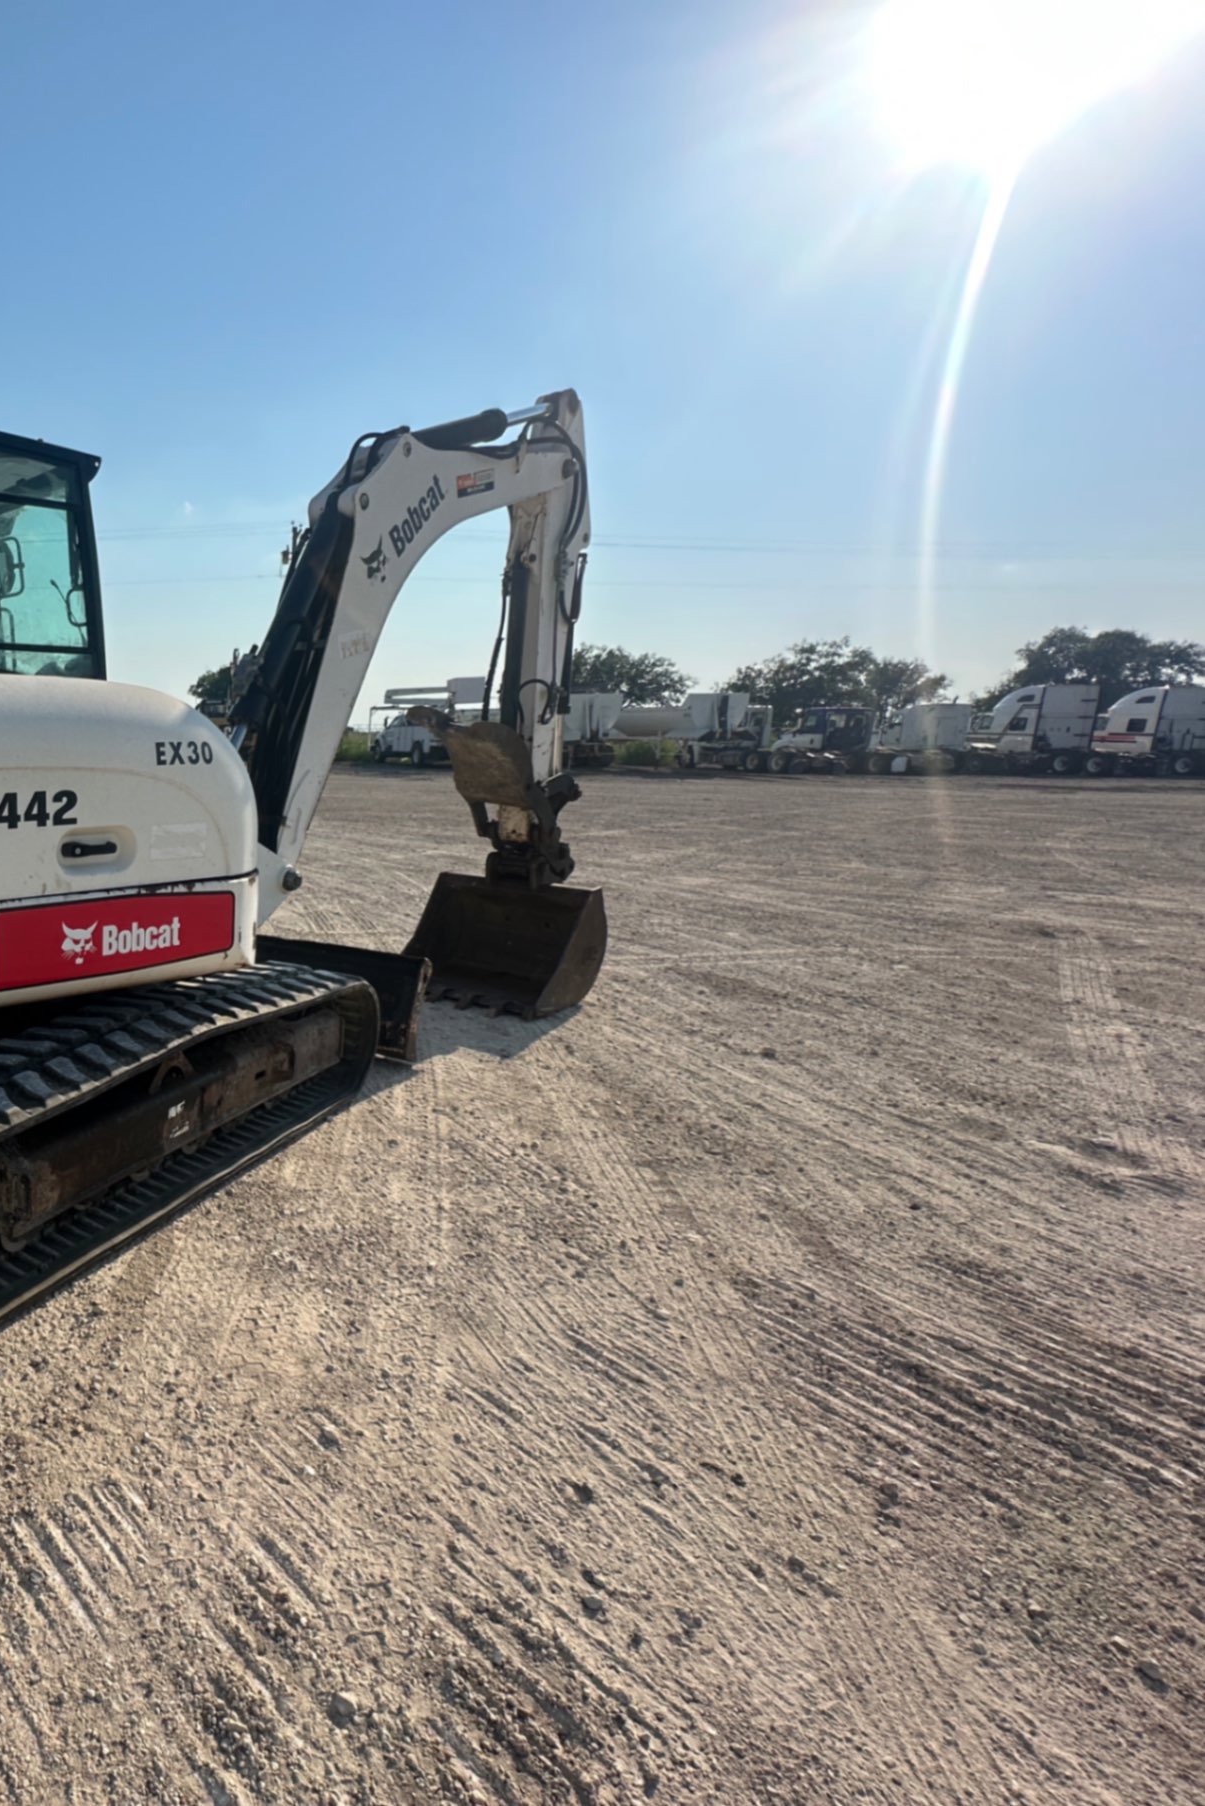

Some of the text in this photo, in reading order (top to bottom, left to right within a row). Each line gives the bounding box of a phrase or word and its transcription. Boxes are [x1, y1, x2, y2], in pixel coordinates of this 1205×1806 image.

[388, 474, 445, 558] Bobcat
[155, 741, 213, 766] EX30
[102, 916, 181, 957] Bobcat
